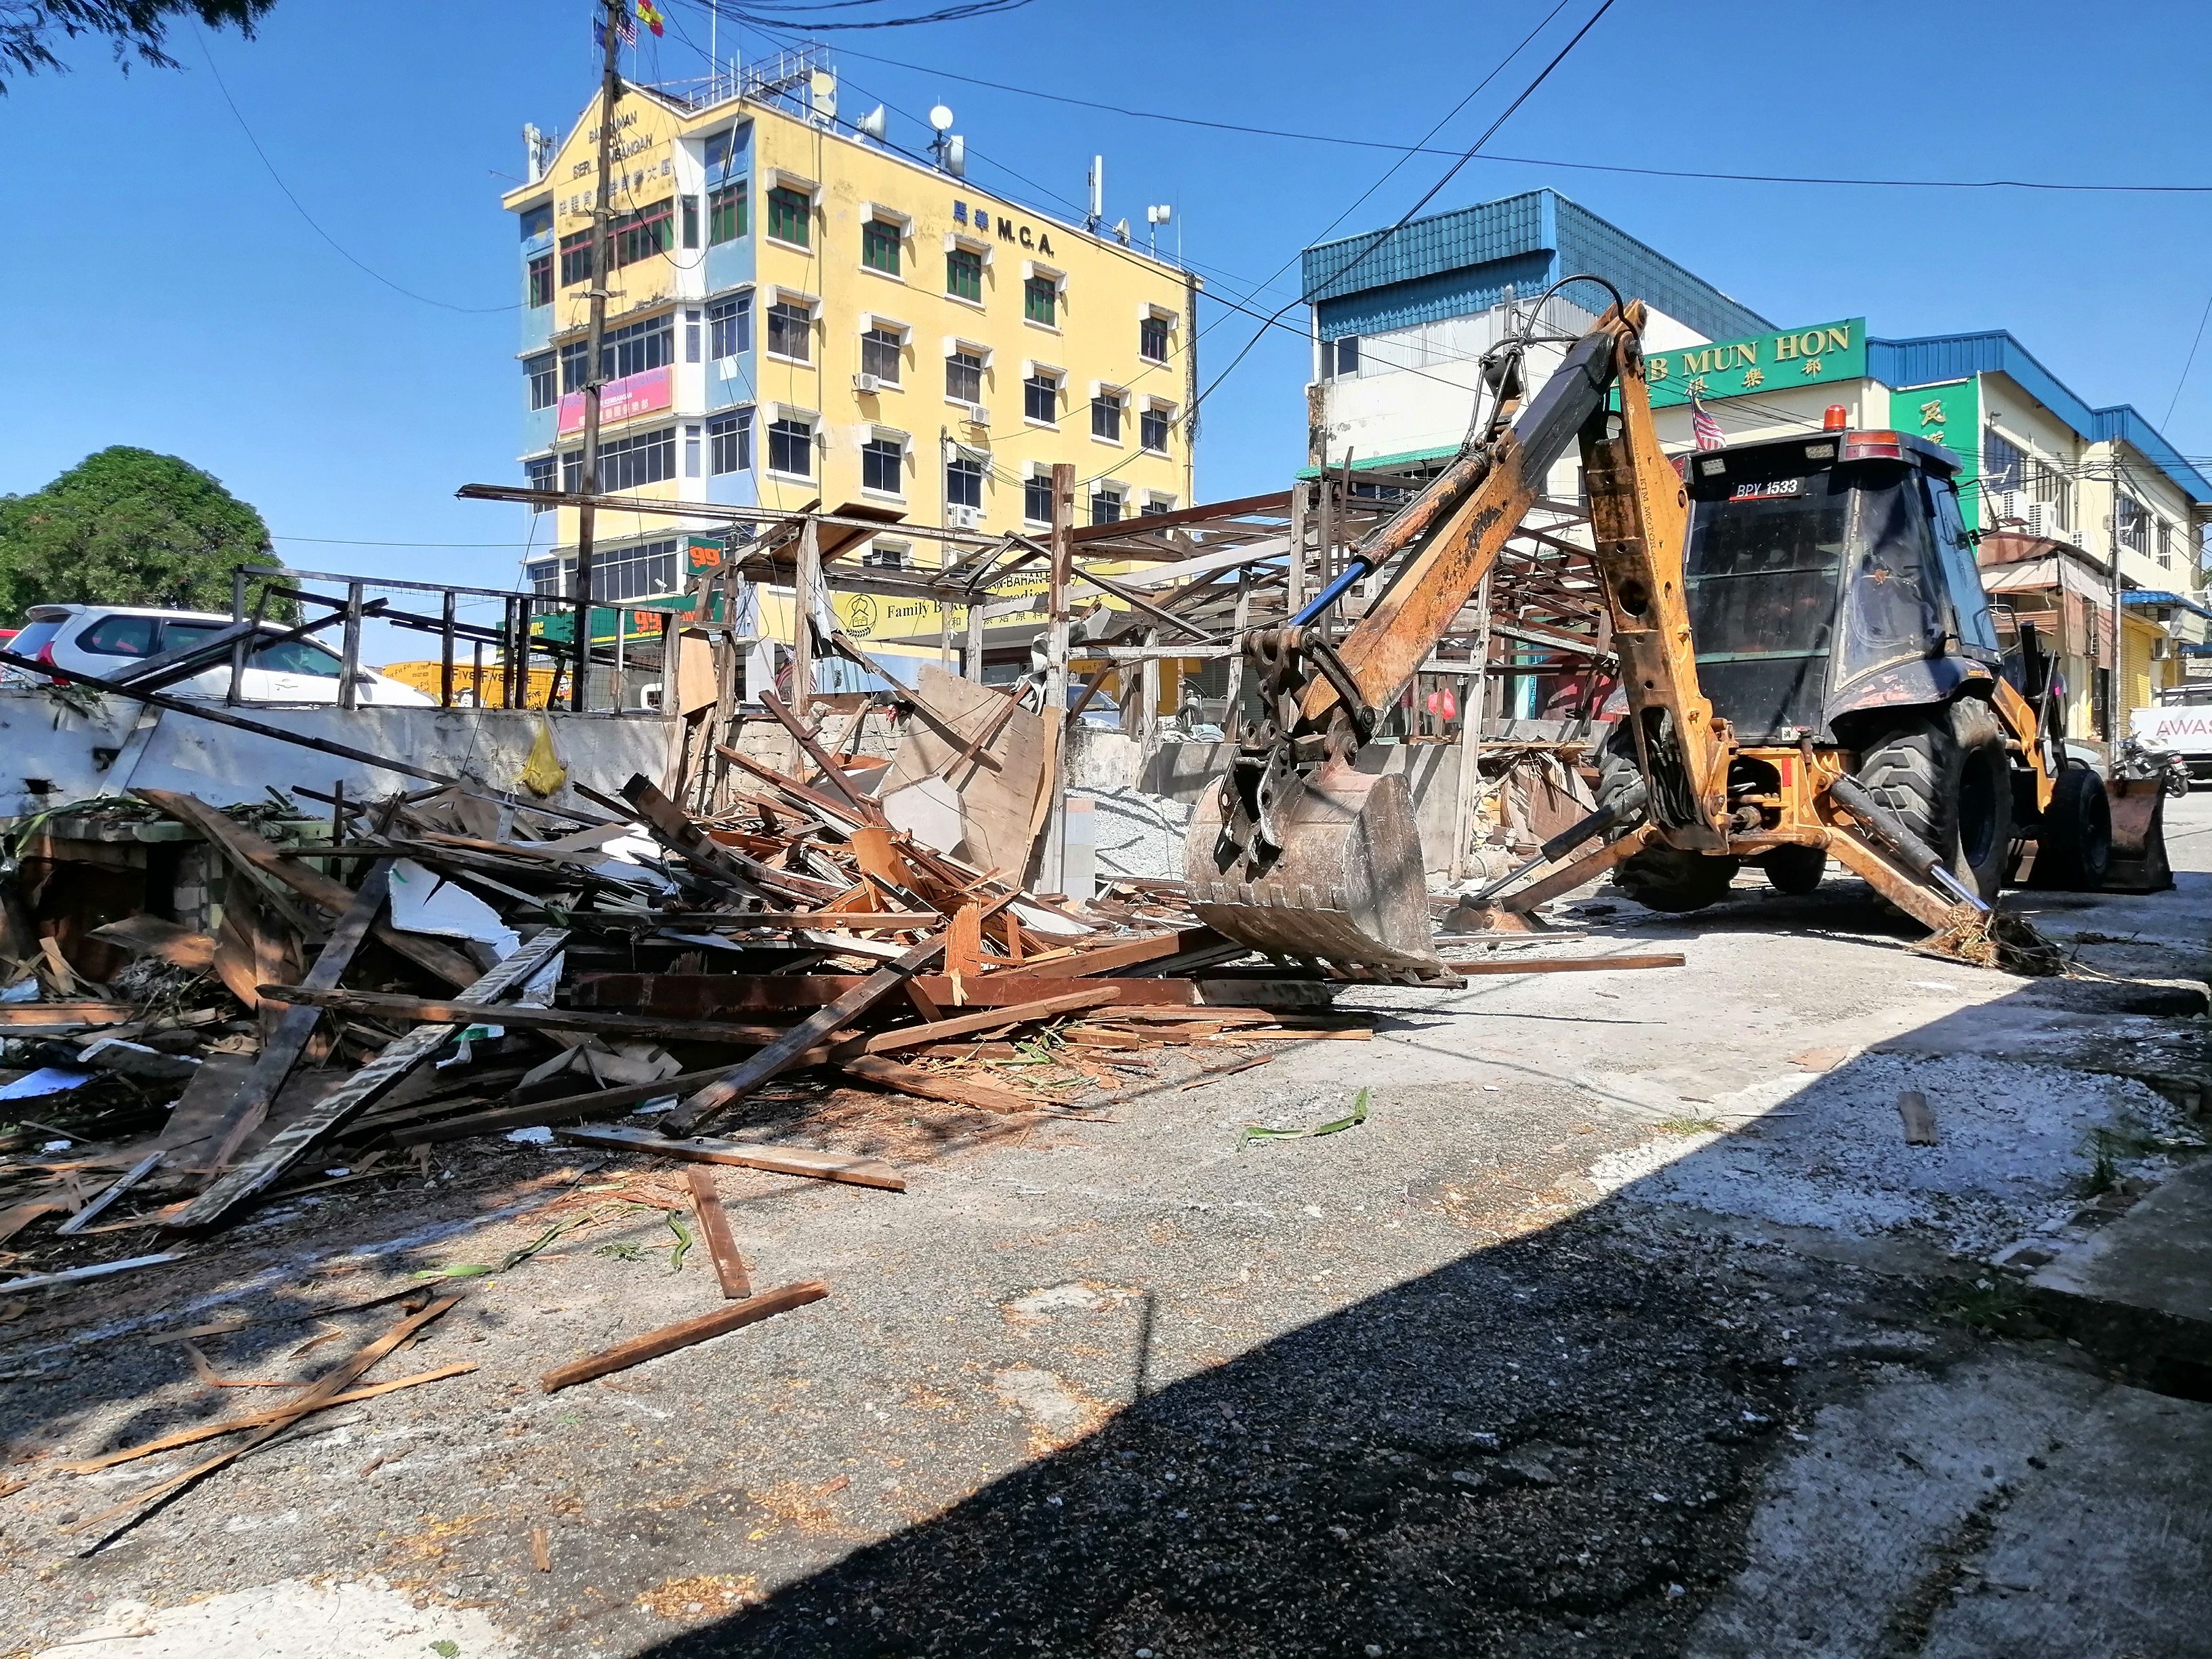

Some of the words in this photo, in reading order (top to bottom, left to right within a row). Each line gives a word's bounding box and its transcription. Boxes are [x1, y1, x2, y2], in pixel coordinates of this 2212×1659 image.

[1682, 342, 1758, 376] MUN
[1774, 325, 1851, 363] HON
[1736, 483, 1762, 497] BPY
[1766, 478, 1798, 495] 1533
[887, 602, 929, 618] Family
